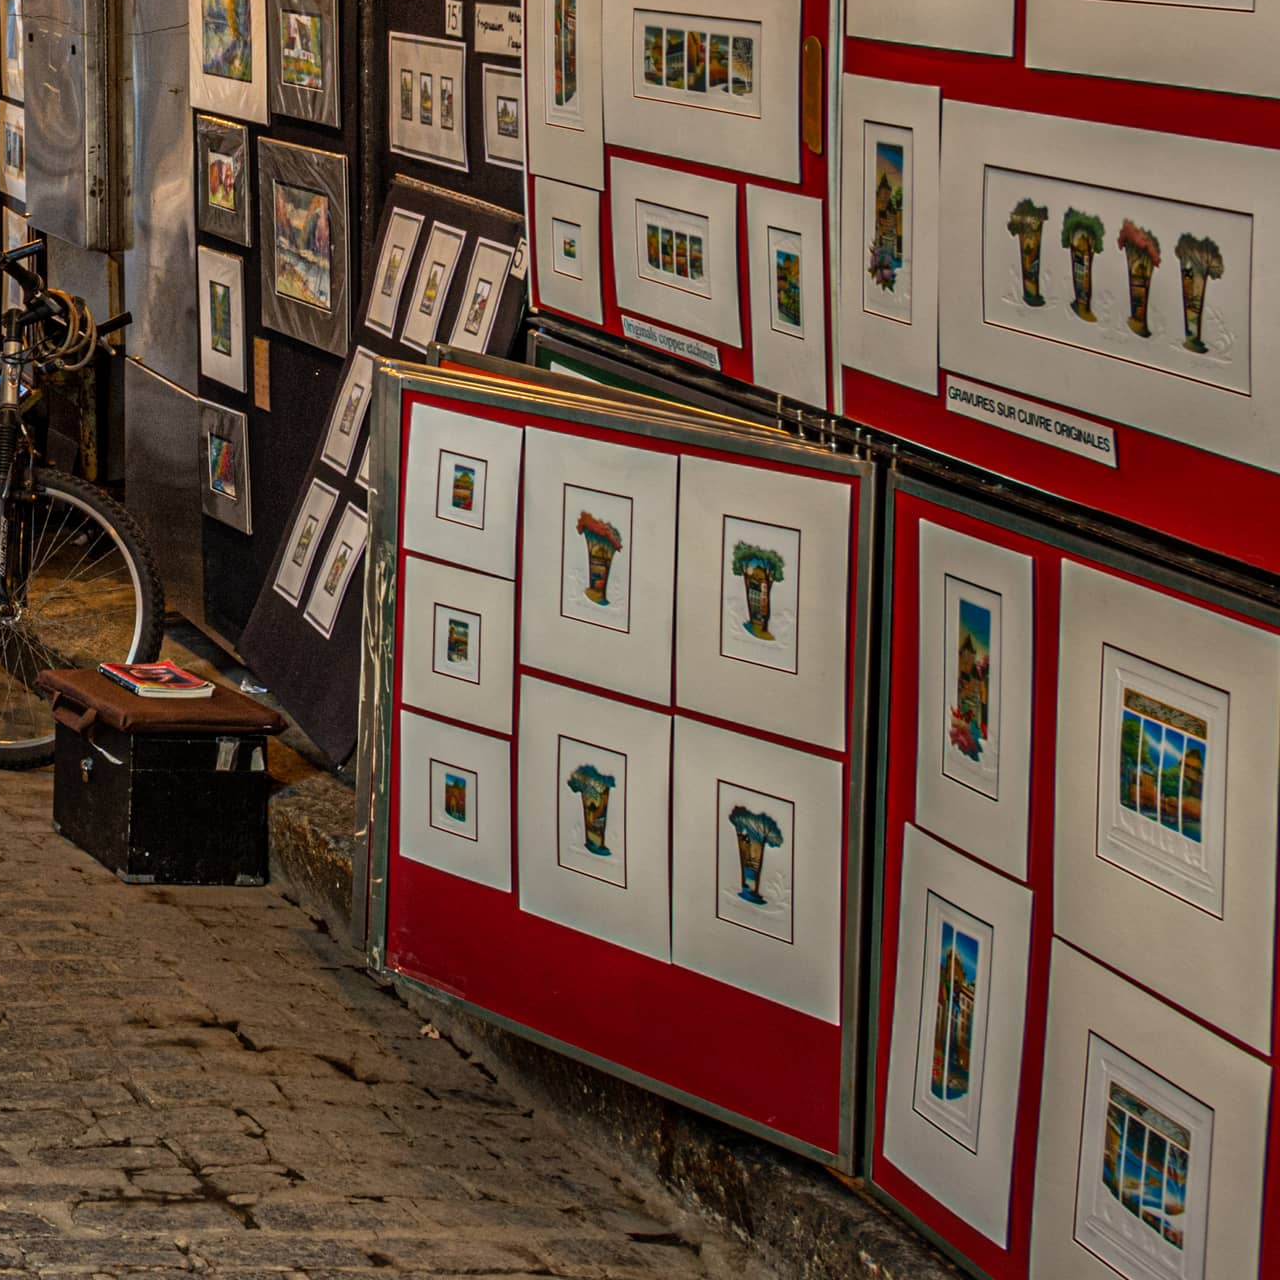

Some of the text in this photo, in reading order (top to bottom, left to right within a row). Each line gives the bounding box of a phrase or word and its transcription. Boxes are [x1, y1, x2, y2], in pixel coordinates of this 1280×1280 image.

[659, 332, 685, 354] copper
[948, 385, 1111, 453] GRAVURES SUR CUIVRE ORIGINALES
